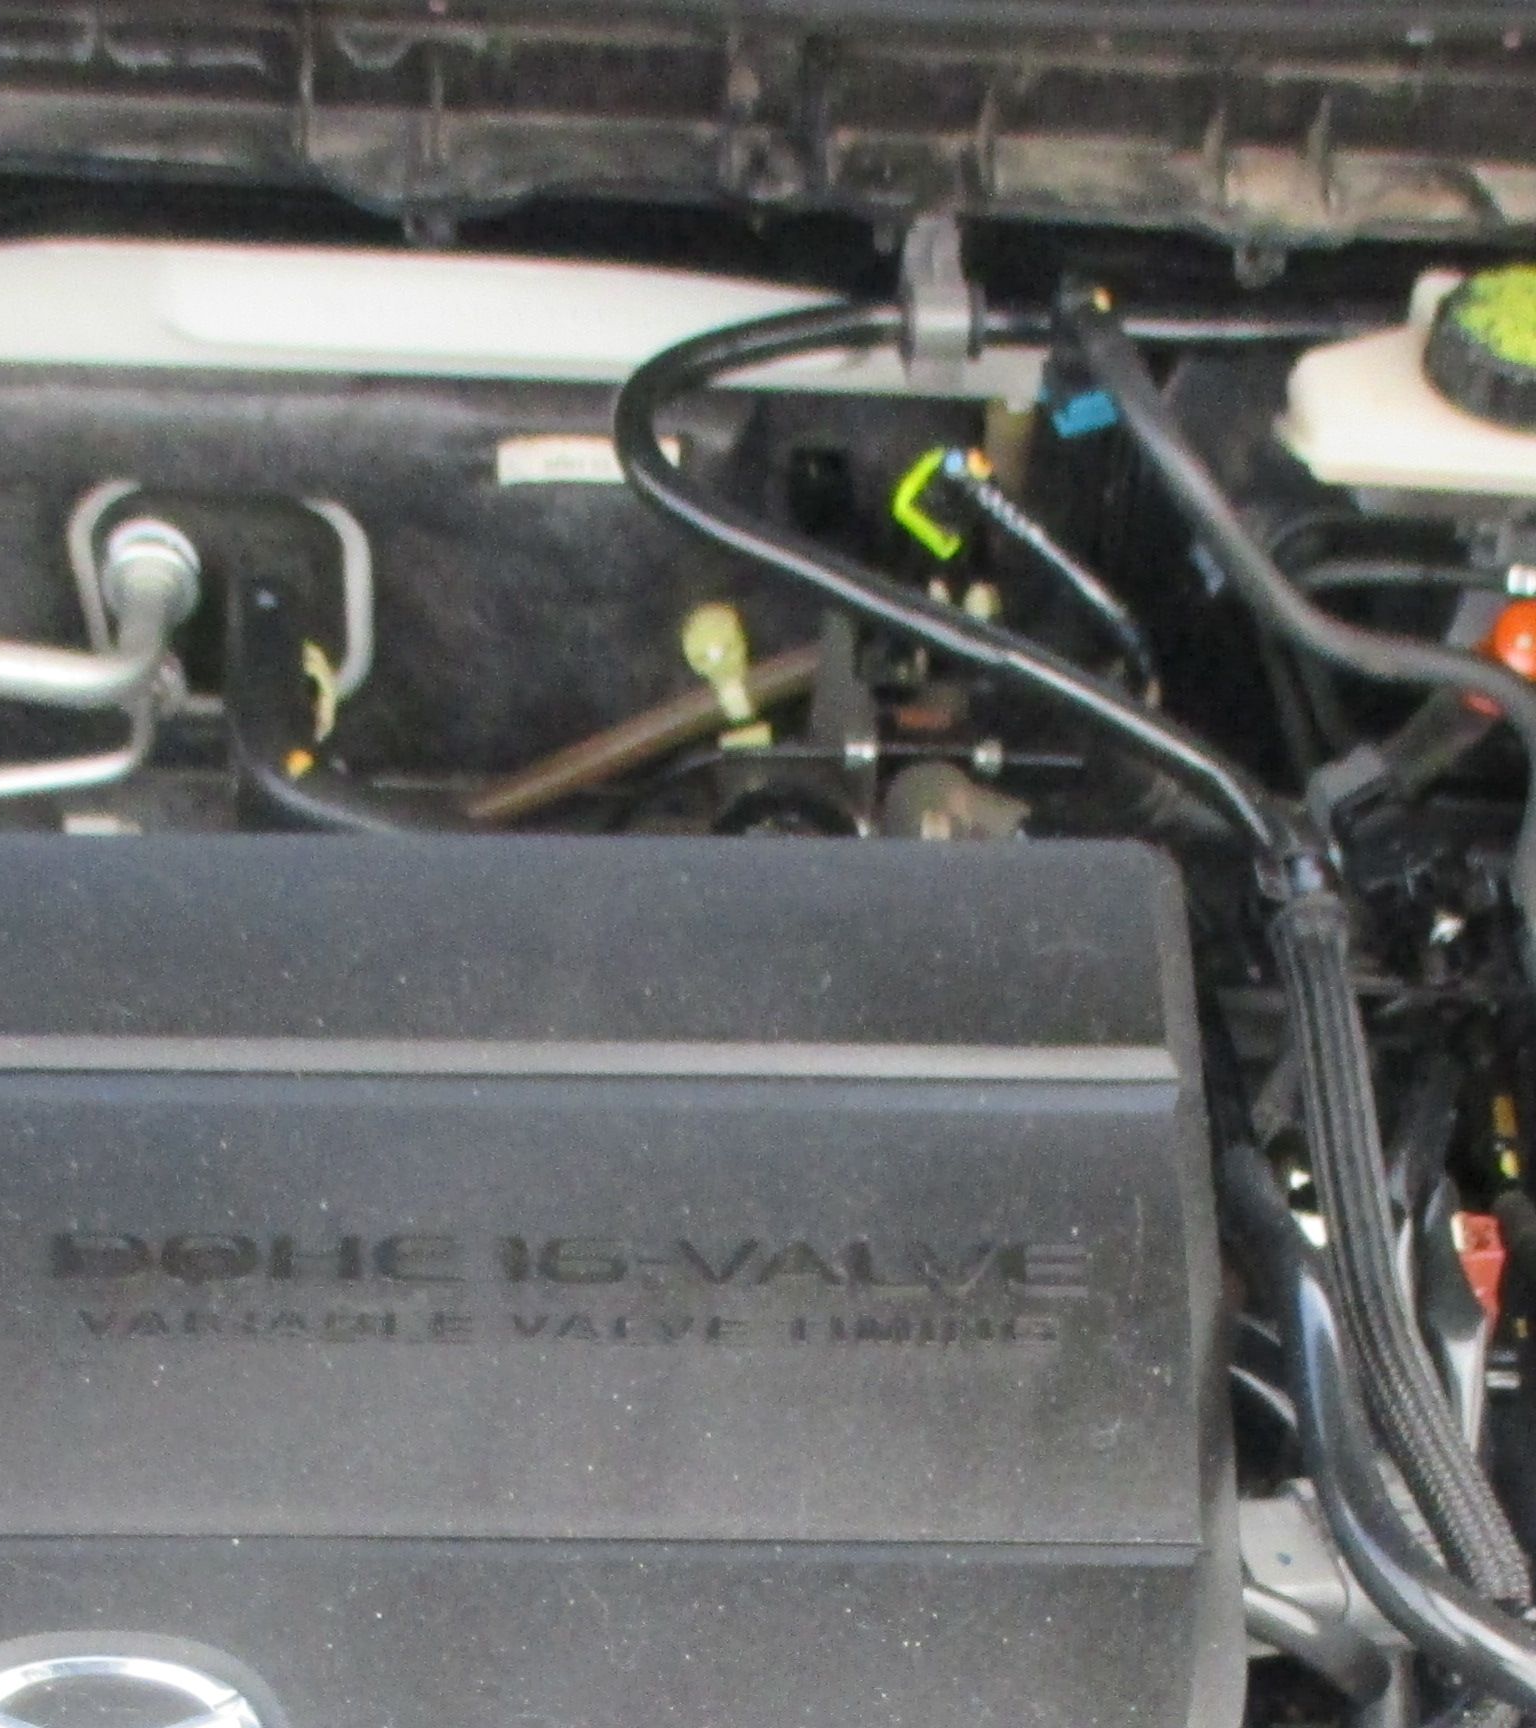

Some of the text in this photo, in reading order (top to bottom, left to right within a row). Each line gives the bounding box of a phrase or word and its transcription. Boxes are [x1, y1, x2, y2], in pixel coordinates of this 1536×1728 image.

[53, 1232, 1088, 1298] DOHC 16-VALVE
[77, 1309, 1061, 1345] VARIABLE VALVE TIMING
